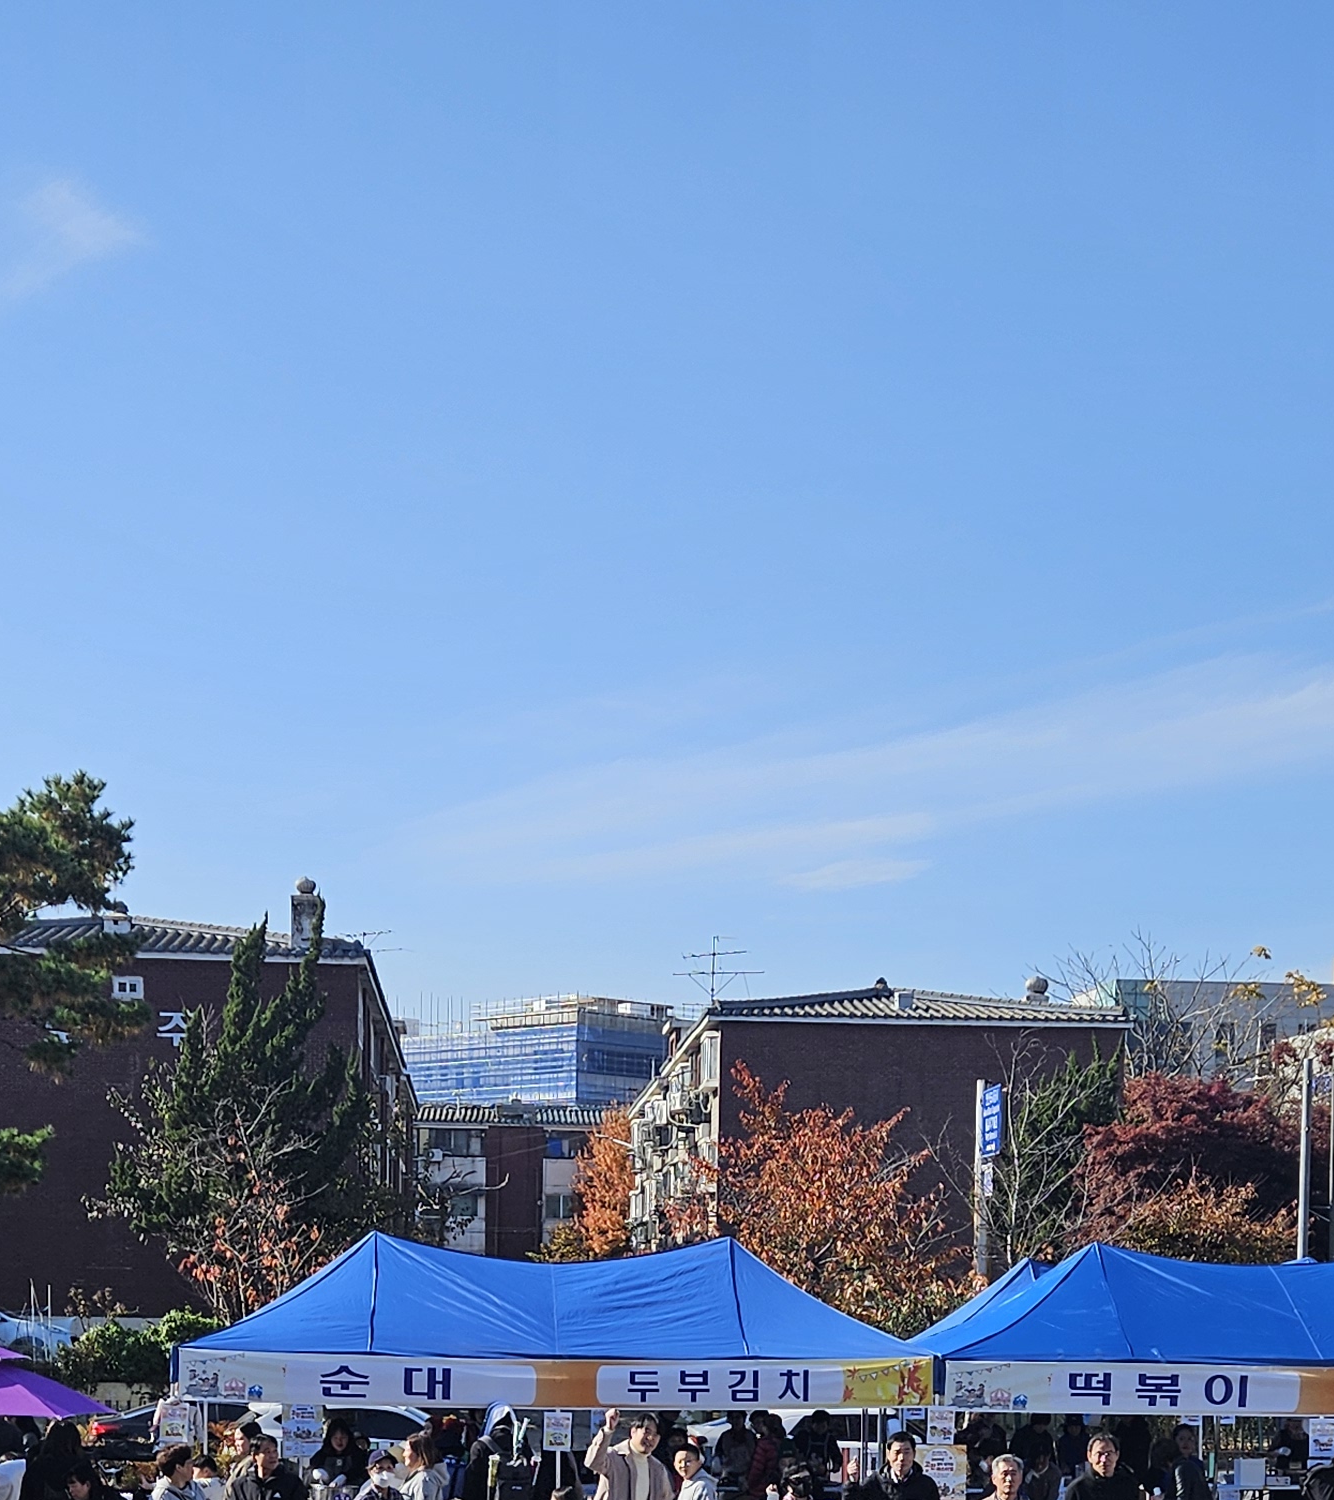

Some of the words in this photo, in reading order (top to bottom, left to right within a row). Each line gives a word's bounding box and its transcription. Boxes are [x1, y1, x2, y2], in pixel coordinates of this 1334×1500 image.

[319, 1365, 452, 1400] 순대
[627, 1369, 810, 1403] 두부김치
[1068, 1372, 1249, 1408] 떡볶이
